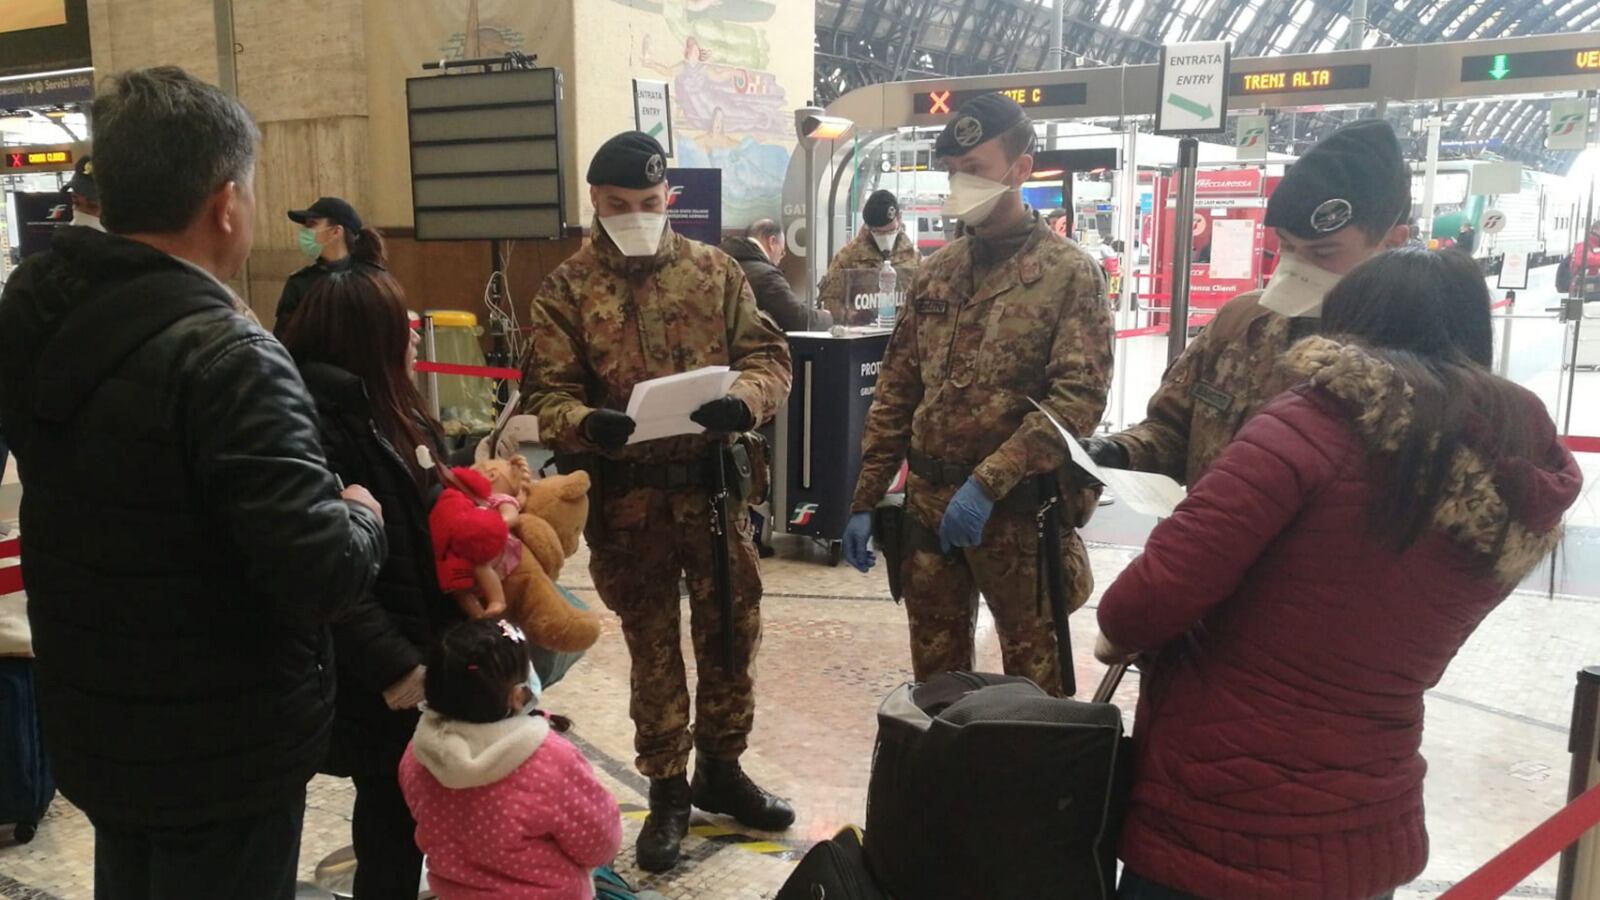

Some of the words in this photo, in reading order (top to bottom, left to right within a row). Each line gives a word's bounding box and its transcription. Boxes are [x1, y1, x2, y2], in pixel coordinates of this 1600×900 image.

[1169, 54, 1222, 66] ENTRATA
[1576, 51, 1600, 68] VE
[1176, 74, 1214, 86] ENTRY
[1244, 73, 1286, 90] TRENI
[1292, 70, 1330, 87] ALTA
[997, 89, 1025, 103] TE
[1032, 88, 1041, 103] C
[642, 106, 661, 115] ENTRY
